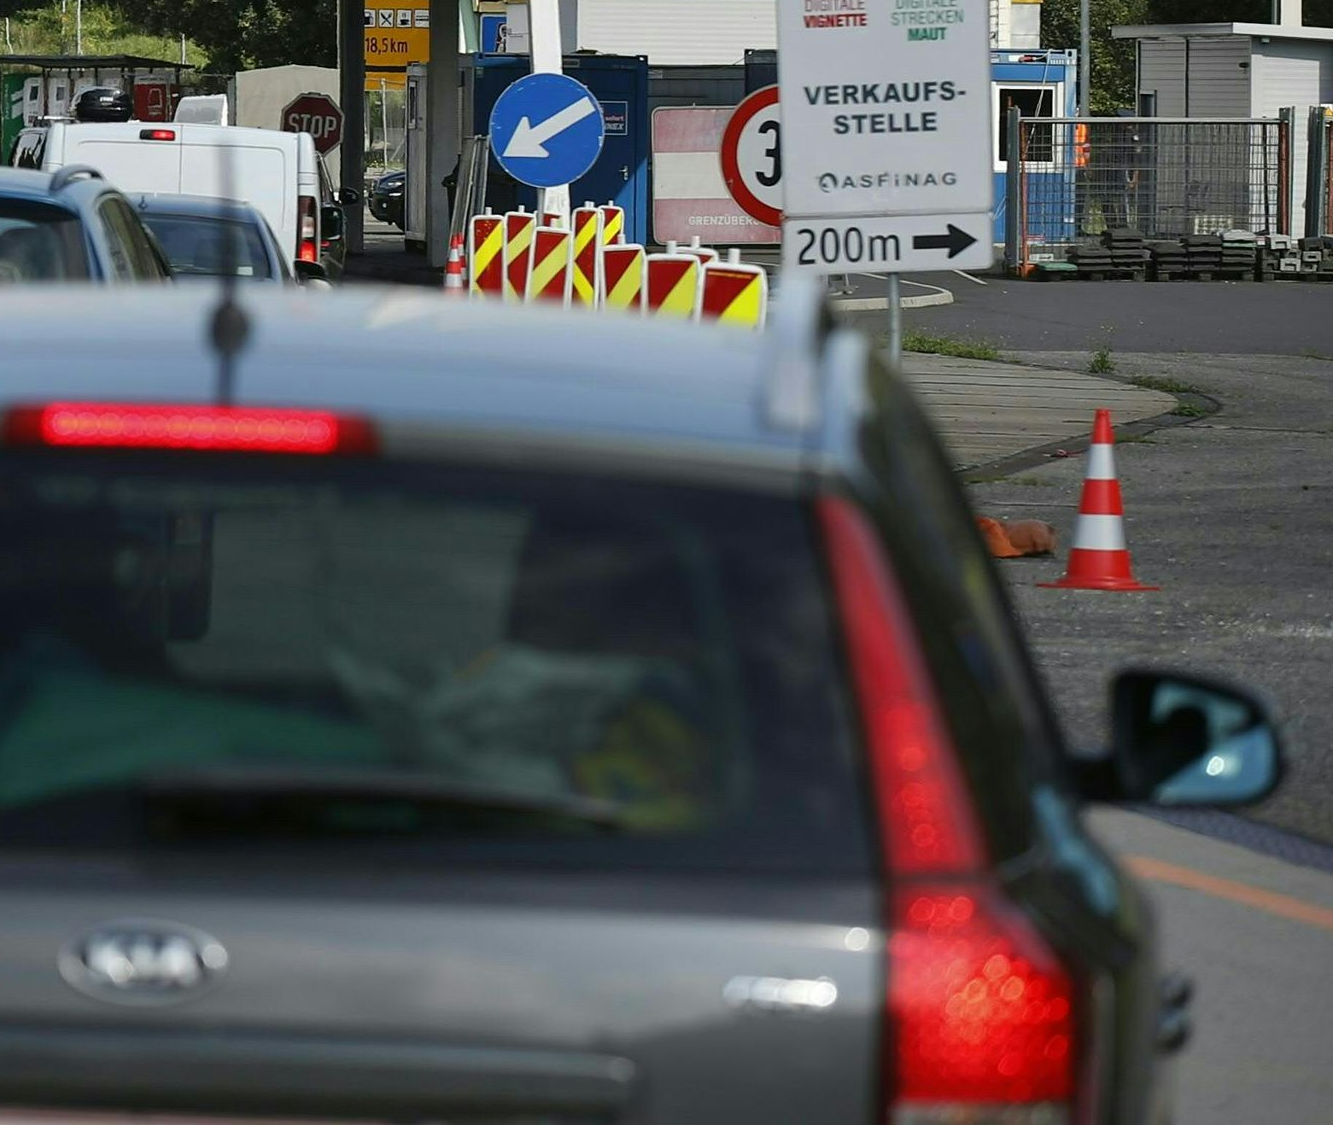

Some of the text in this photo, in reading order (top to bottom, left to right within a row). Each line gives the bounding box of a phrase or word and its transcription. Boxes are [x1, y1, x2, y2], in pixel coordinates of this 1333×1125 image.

[803, 13, 868, 28] VIGNETTE
[891, 9, 964, 26] STRECKEN
[907, 27, 947, 41] MAUT
[365, 37, 408, 55] 18,5 km
[804, 81, 966, 105] VERKAUFS-
[288, 113, 337, 139] STOP
[834, 112, 938, 135] STELLE
[797, 227, 901, 265] 200m
